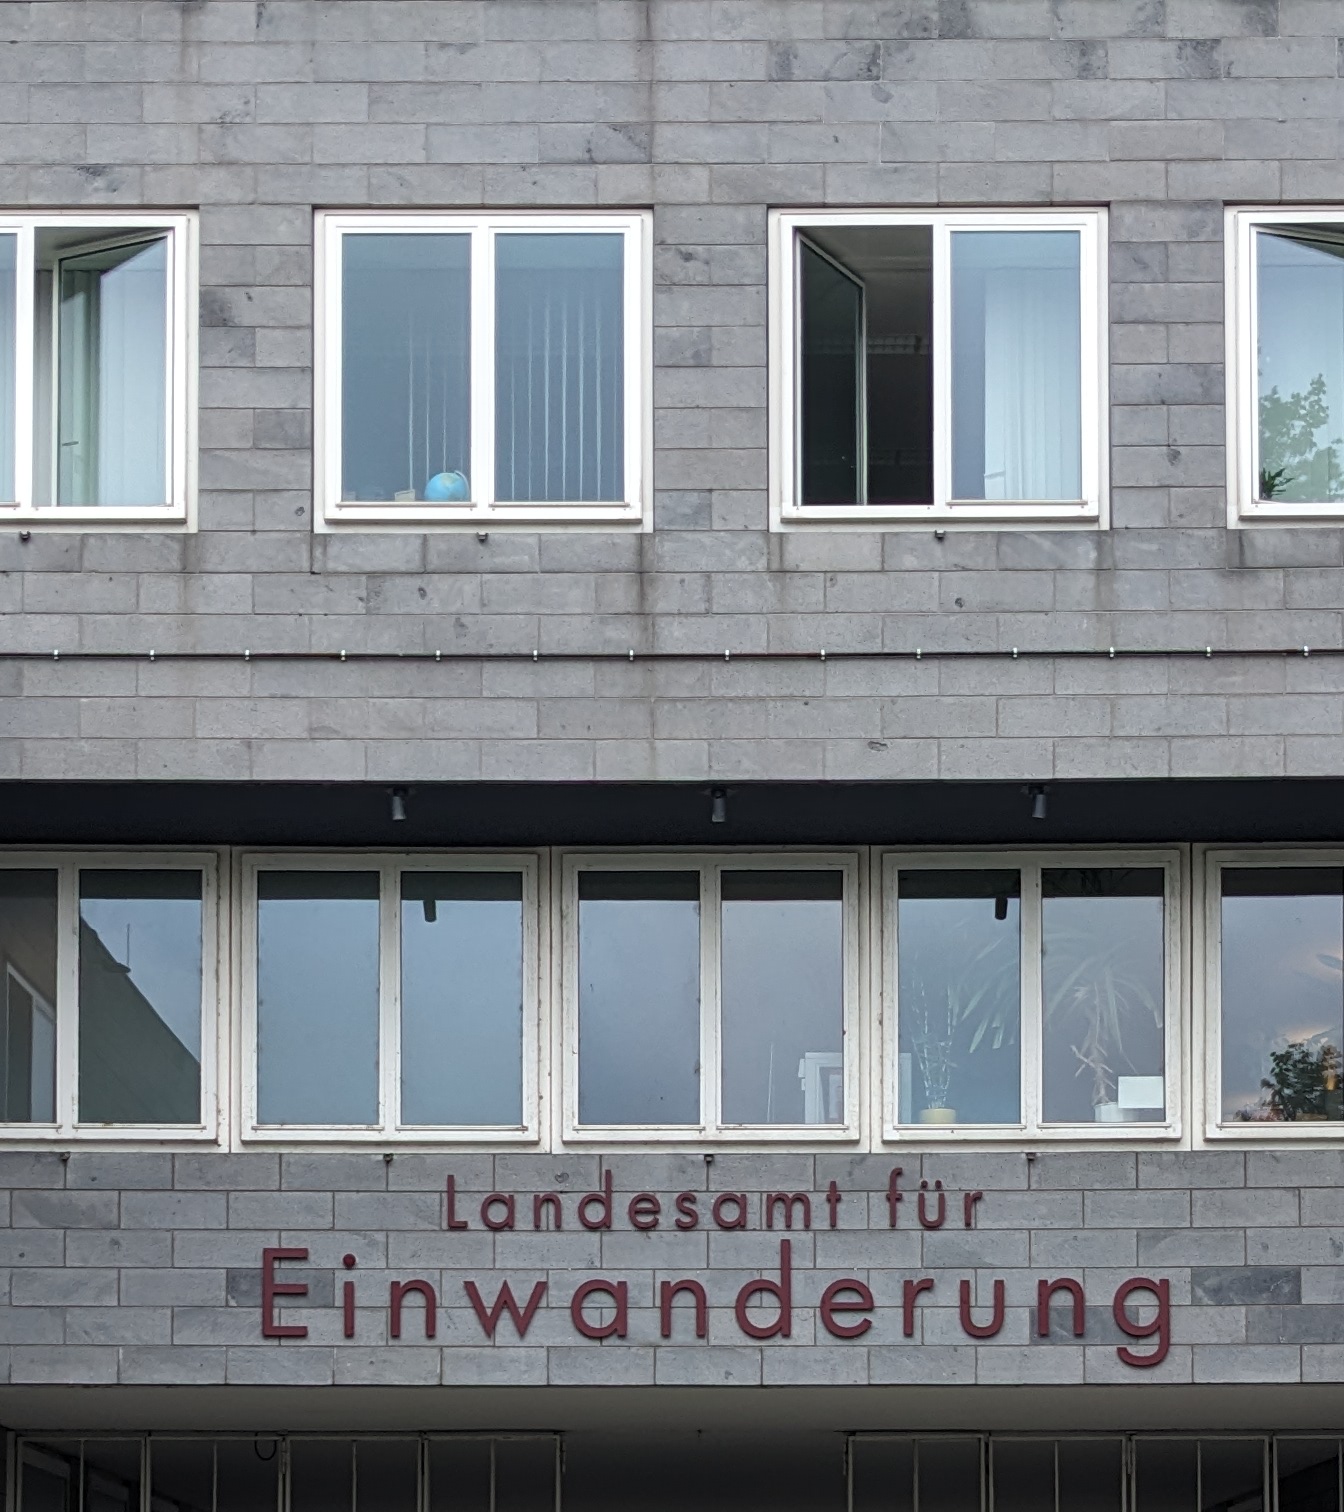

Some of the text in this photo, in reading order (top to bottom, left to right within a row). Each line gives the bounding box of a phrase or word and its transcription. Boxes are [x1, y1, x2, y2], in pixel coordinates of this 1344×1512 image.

[445, 1167, 984, 1230] Landesamt für
[261, 1239, 1170, 1367] Einwanderung
